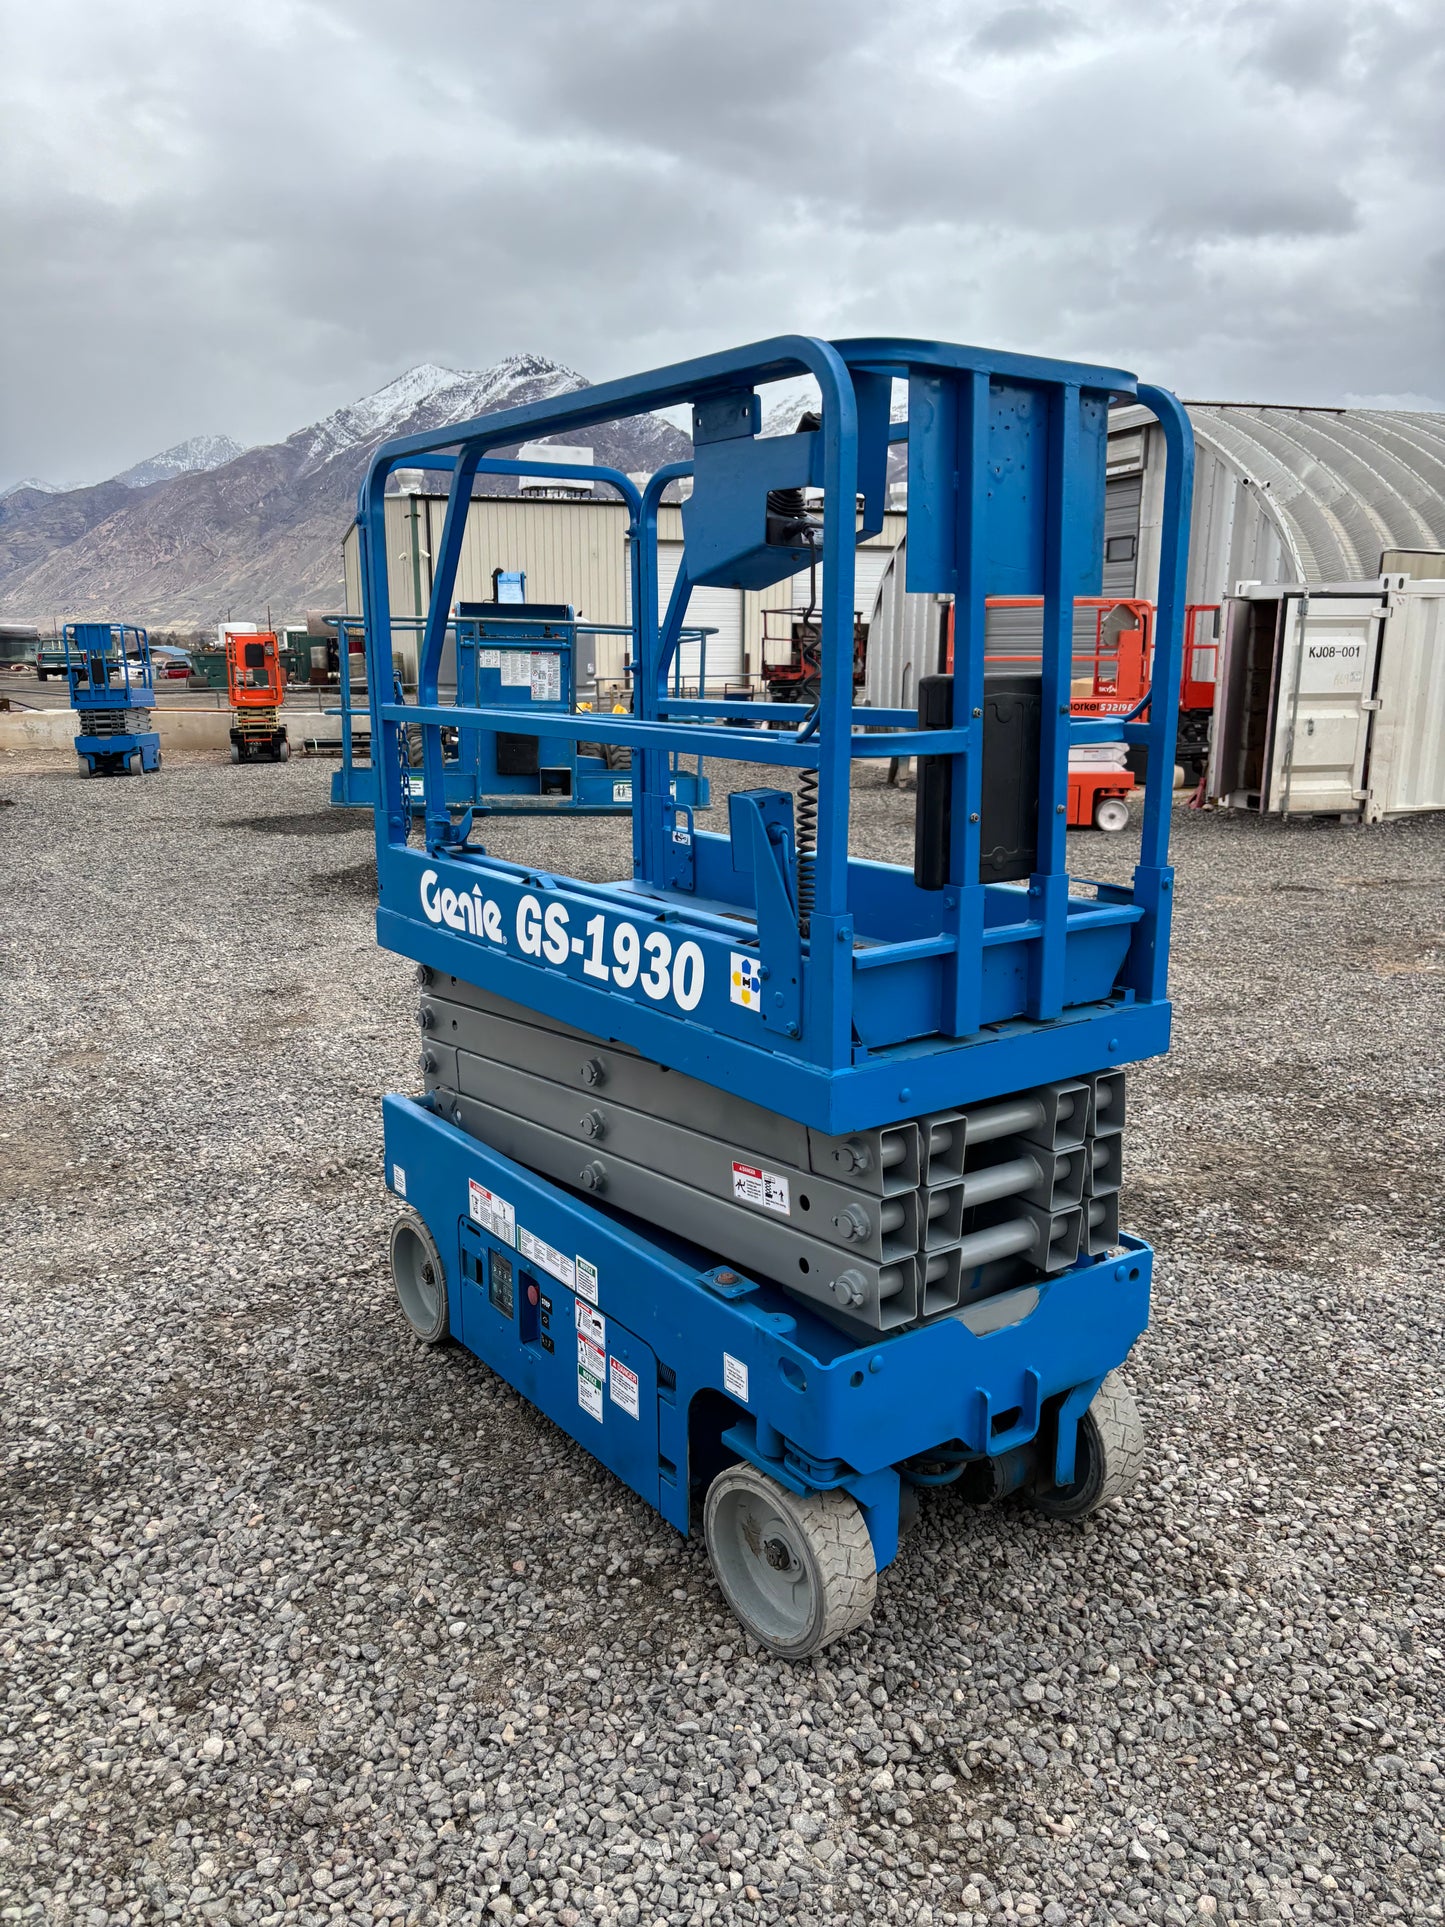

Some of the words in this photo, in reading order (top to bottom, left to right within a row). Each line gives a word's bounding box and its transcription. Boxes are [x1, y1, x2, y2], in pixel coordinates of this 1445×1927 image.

[1308, 646, 1360, 658] KJ08-001
[1070, 702, 1099, 711] orkel
[420, 870, 502, 944] Genie
[516, 895, 705, 1011] GS-1930
[617, 1361, 637, 1384] DANGER
